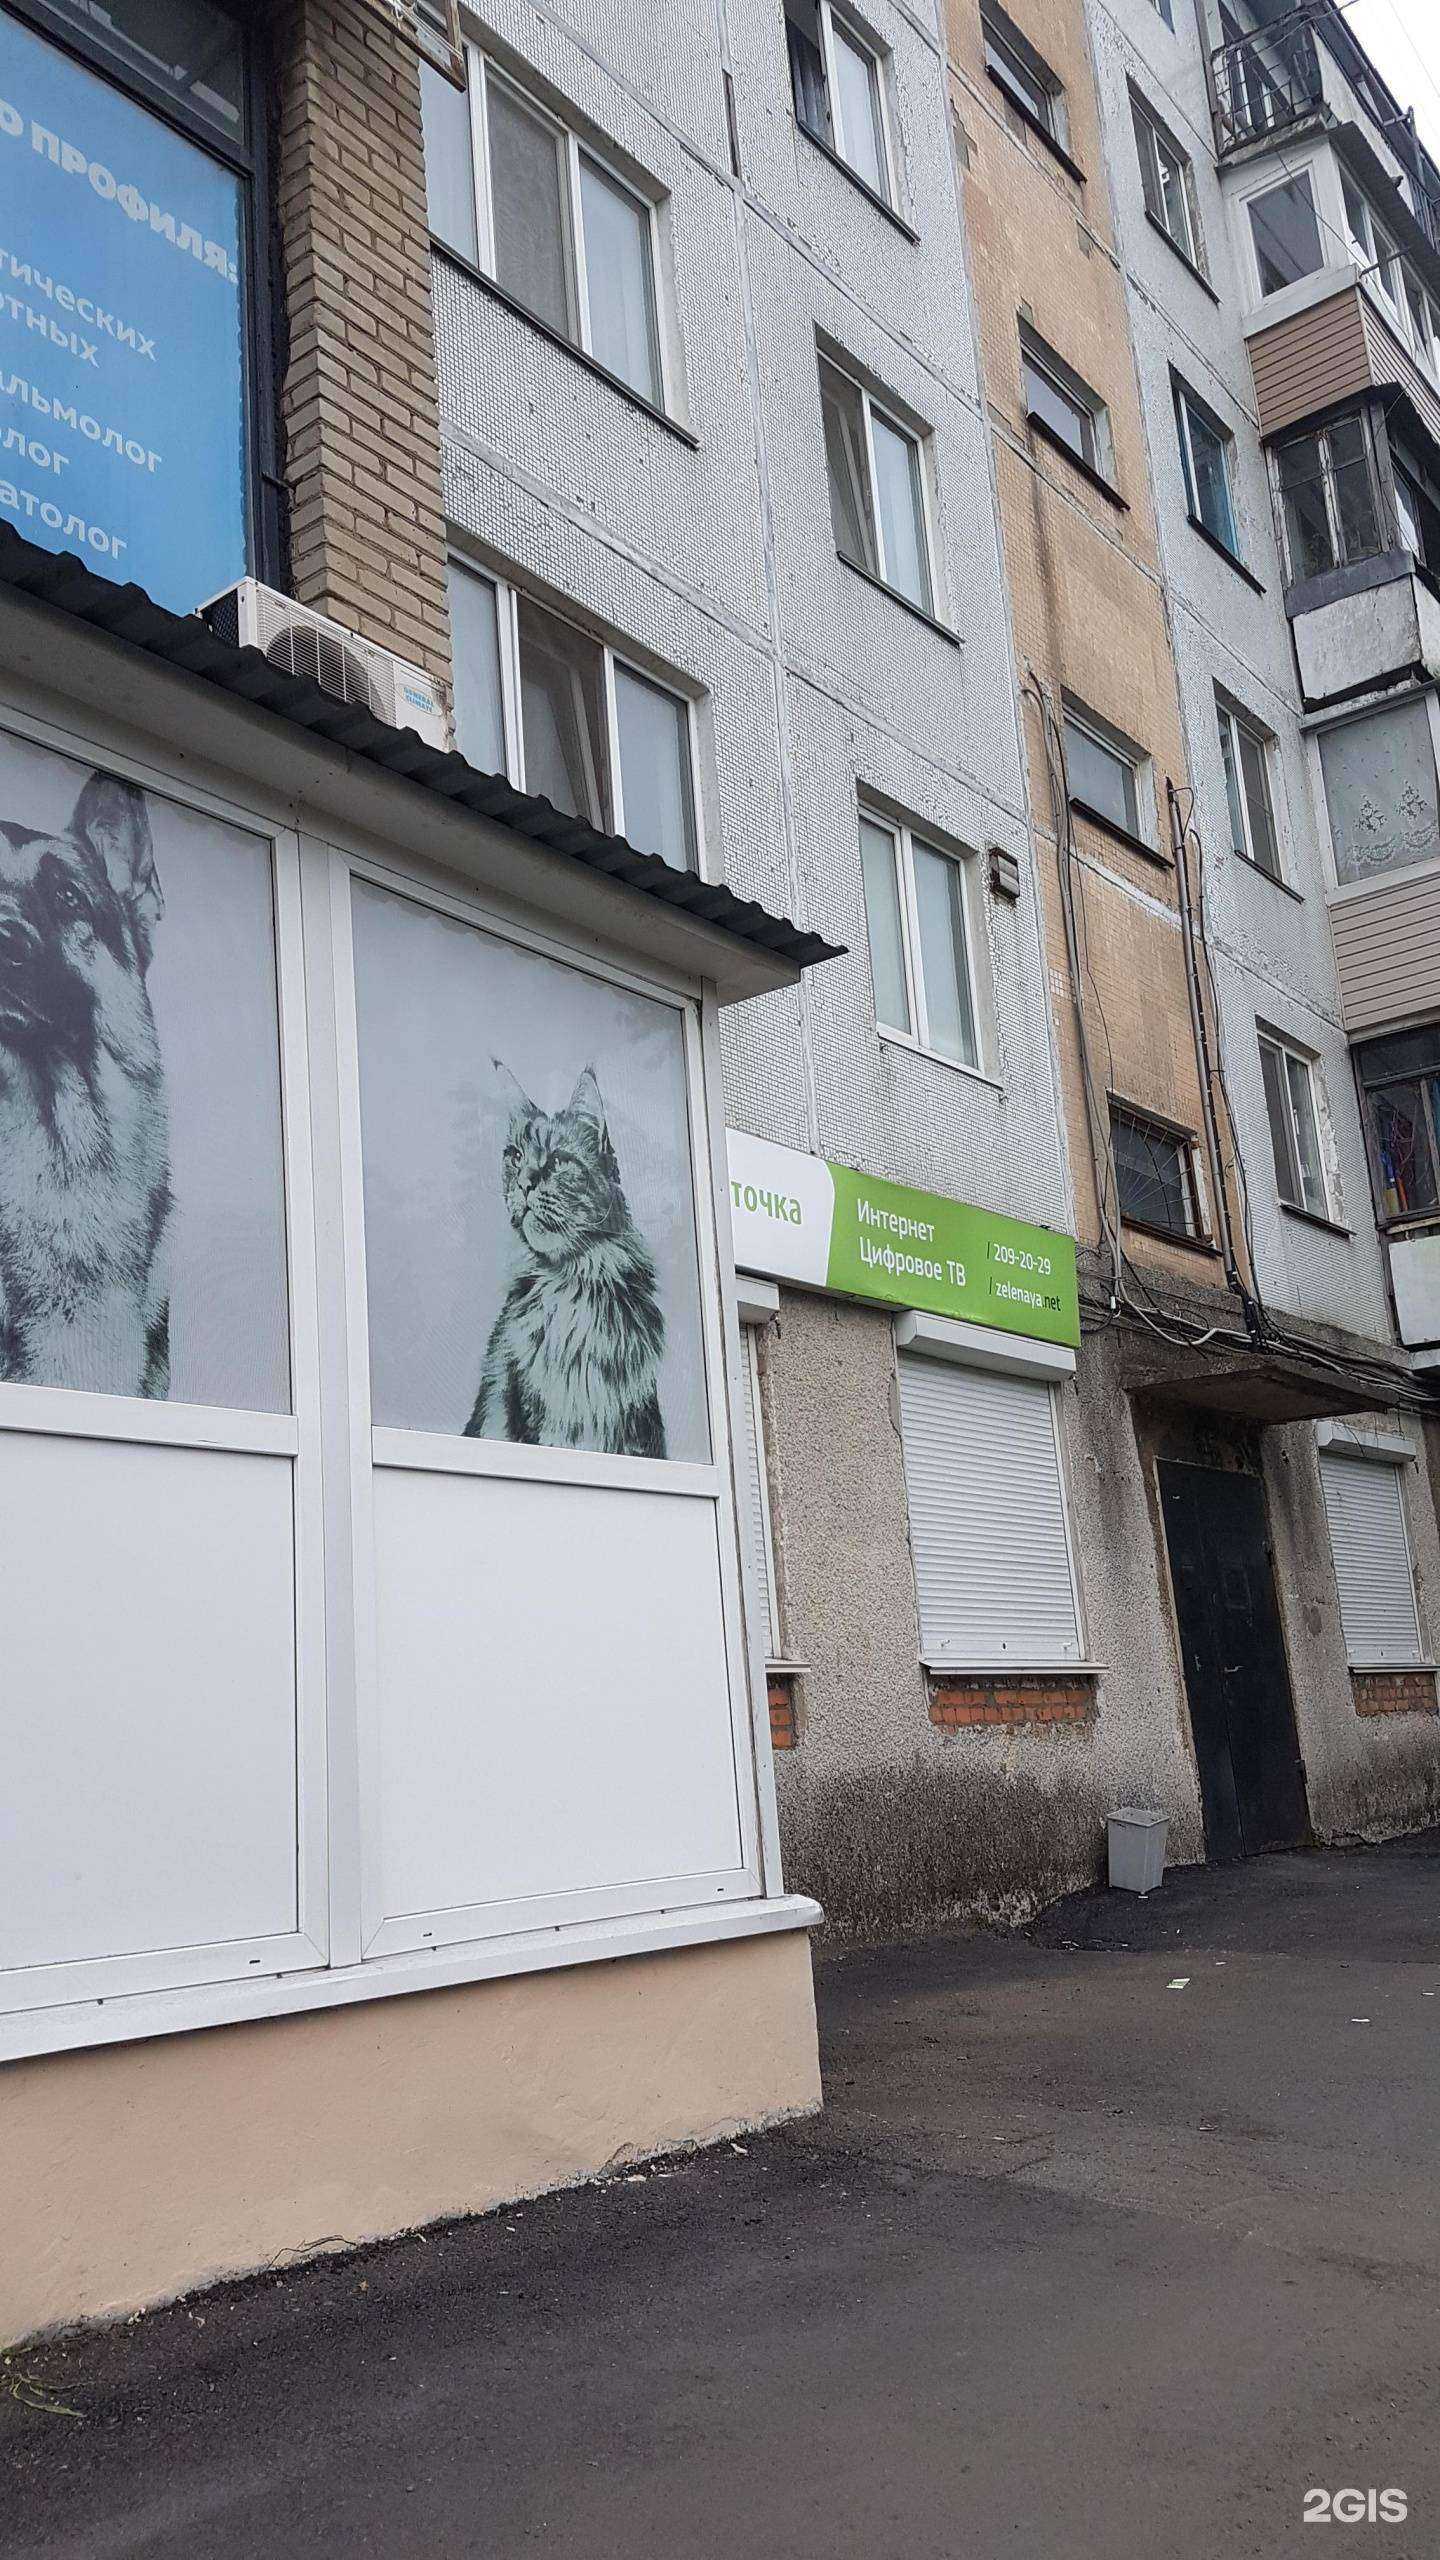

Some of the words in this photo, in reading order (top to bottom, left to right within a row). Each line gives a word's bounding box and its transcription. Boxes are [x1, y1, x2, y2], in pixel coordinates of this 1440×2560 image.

[31, 119, 239, 285] ПРОФИЛЯ:
[0, 293, 99, 368] тных
[0, 428, 70, 475] лог
[730, 1180, 802, 1225] точка
[857, 1198, 935, 1242] Интернет
[859, 1237, 943, 1281] Цифровое
[946, 1260, 966, 1287] ТВ
[993, 1243, 1051, 1275] 209-20-29
[996, 1281, 1062, 1312] zelenaya.net
